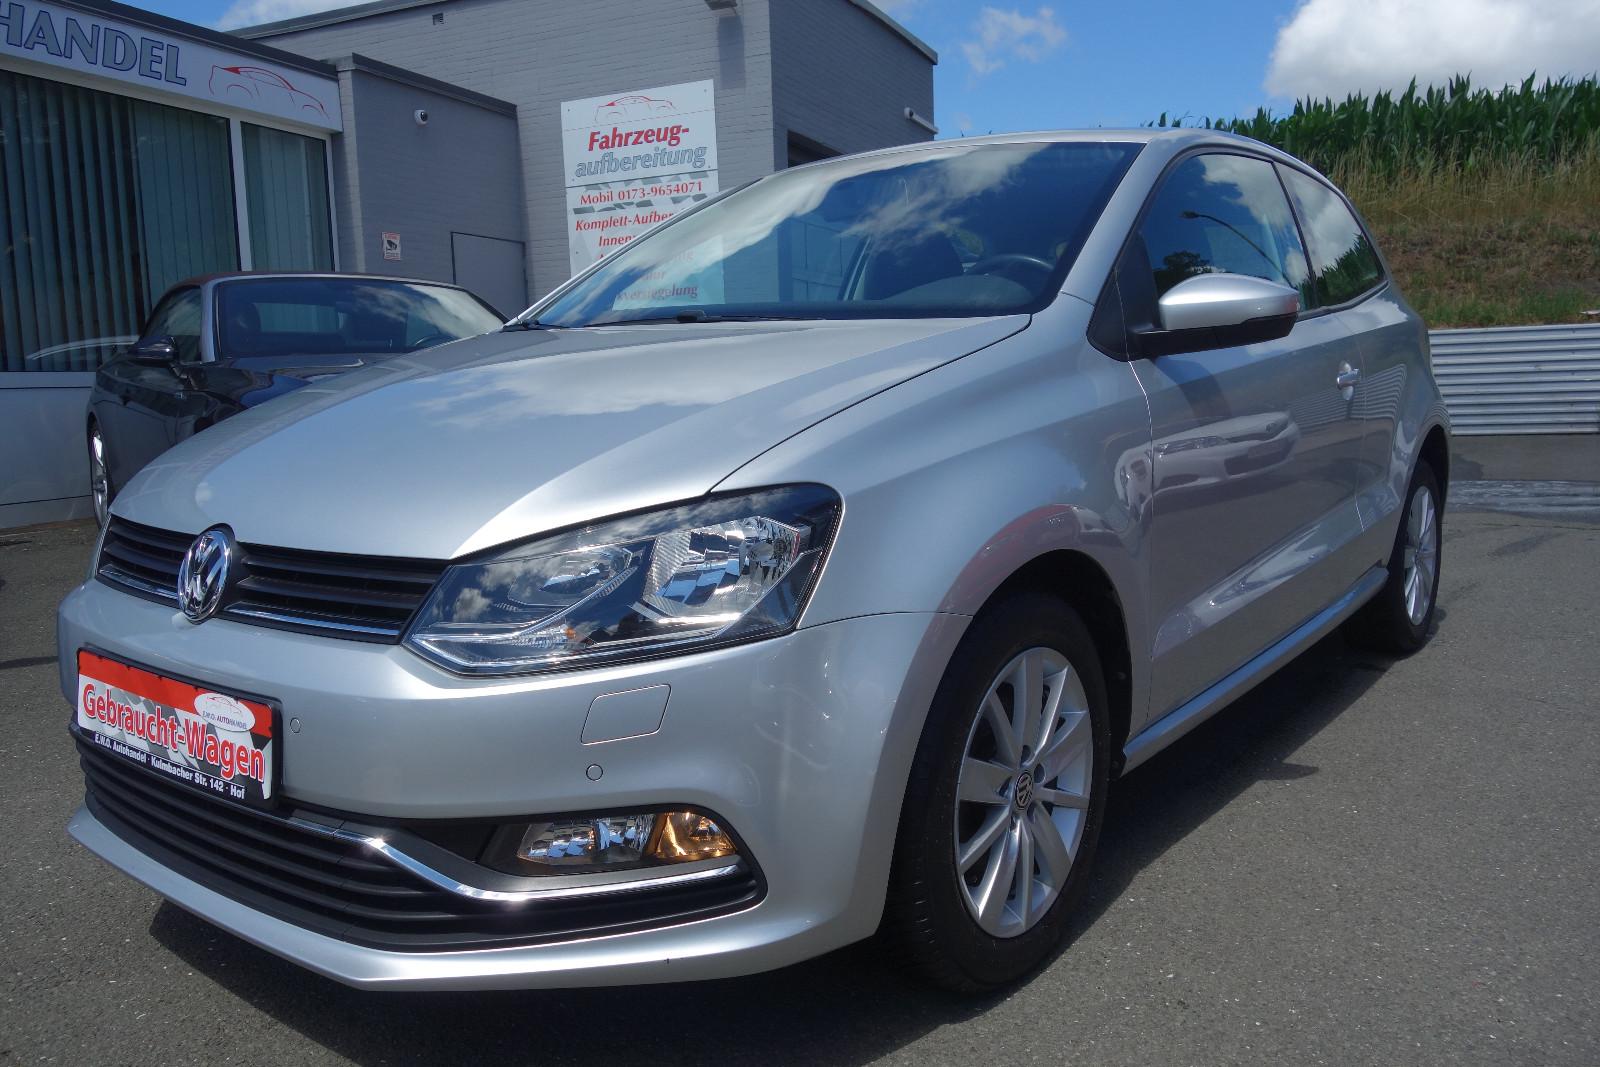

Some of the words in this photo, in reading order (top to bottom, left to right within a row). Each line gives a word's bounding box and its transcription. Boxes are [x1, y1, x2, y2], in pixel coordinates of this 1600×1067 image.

[588, 124, 690, 151] Fahrzeug-
[575, 146, 707, 178] aufbereitung
[580, 191, 614, 205] Mobil
[618, 181, 703, 201] 0173-9654071
[575, 210, 674, 232] Komplett-Aufber
[598, 235, 636, 247] Innen
[83, 683, 265, 783] Gebraucht-Wagen
[113, 743, 147, 763] Autohandel
[151, 755, 193, 781] Kulmbacher
[195, 772, 207, 786] Str.
[210, 778, 224, 793] 142
[231, 785, 245, 800] Hof
